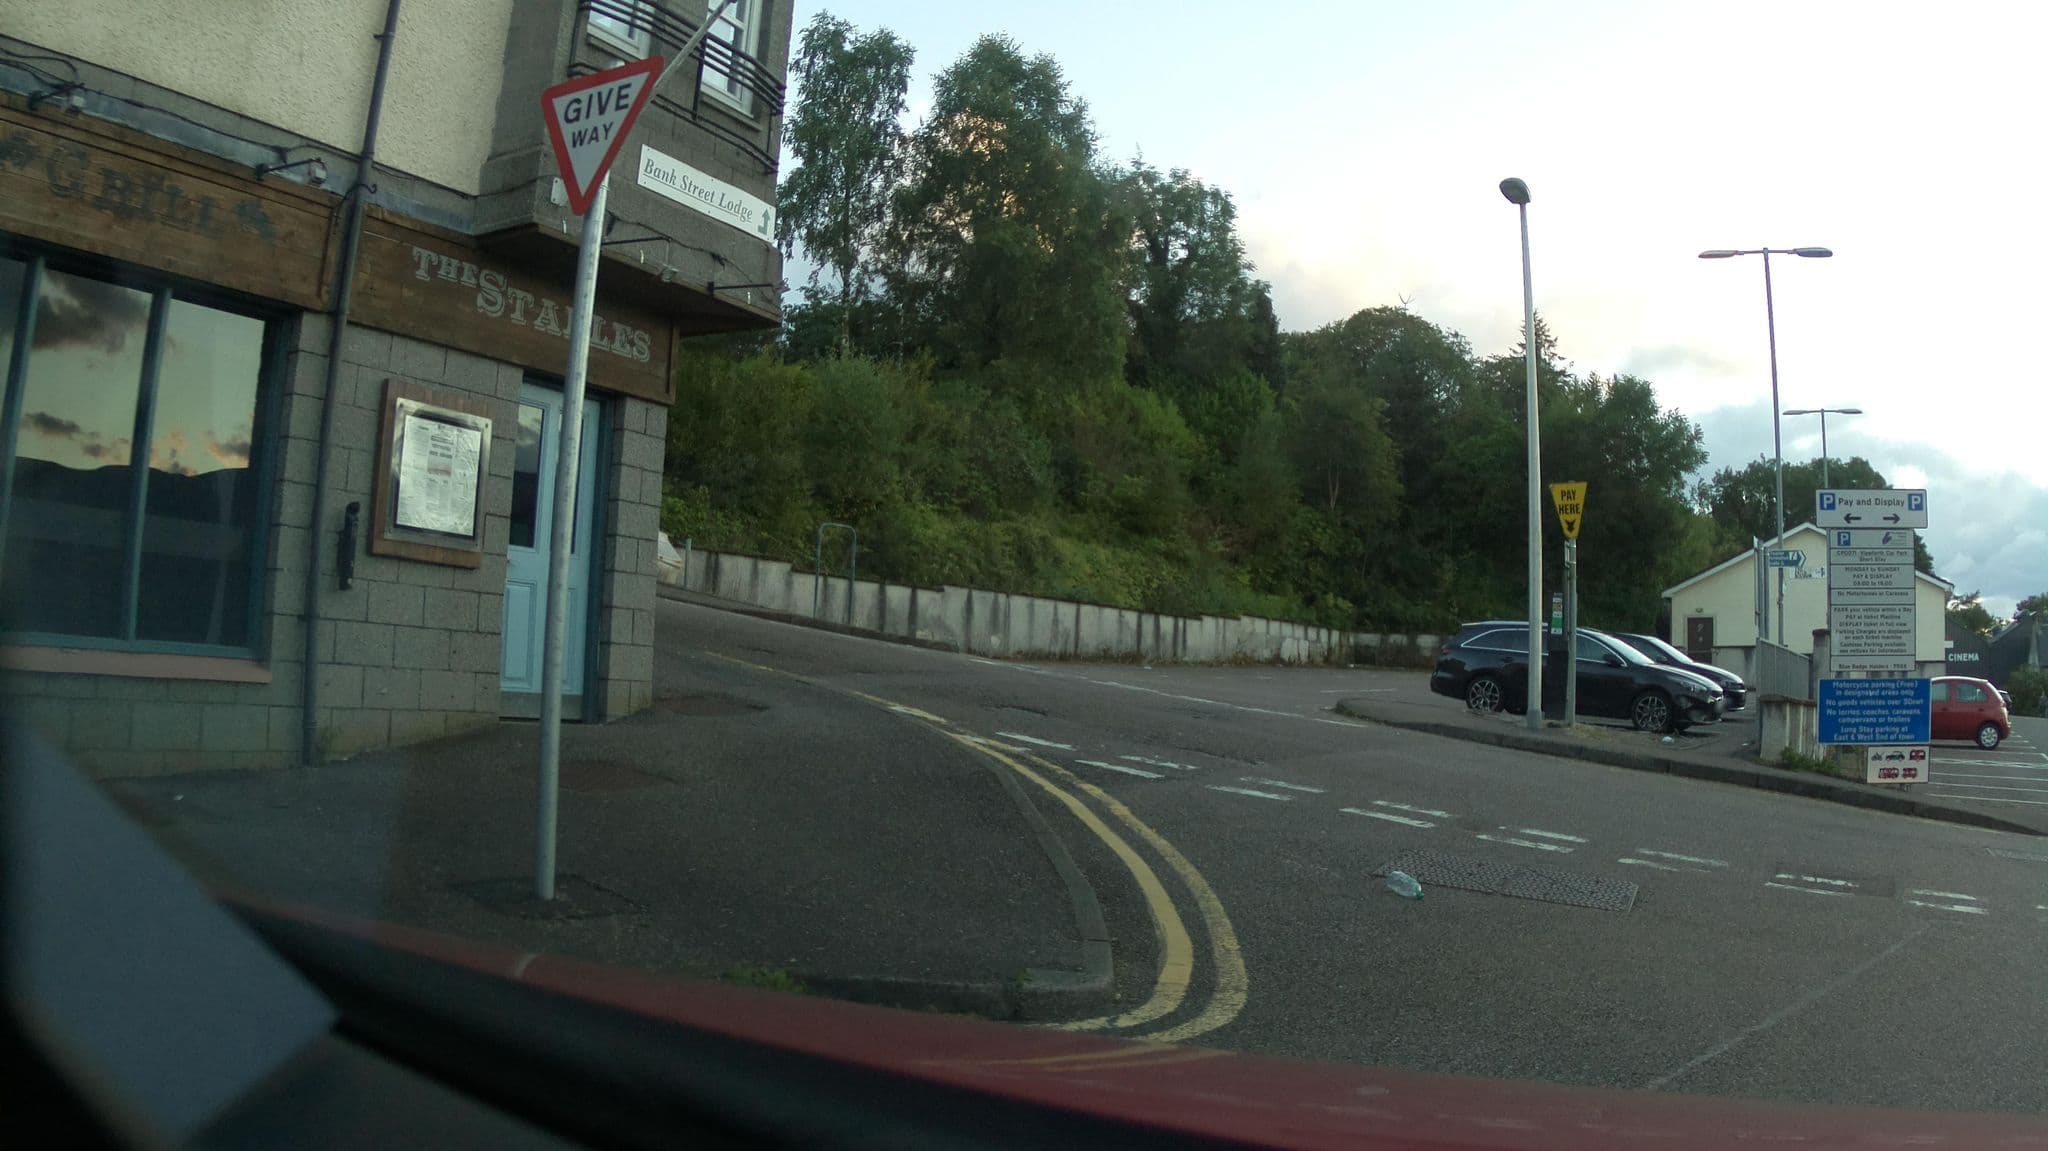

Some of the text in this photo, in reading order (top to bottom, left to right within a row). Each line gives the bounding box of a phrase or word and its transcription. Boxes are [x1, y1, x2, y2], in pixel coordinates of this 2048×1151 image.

[564, 83, 632, 124] GIVE
[571, 122, 614, 148] WAY
[643, 158, 753, 222] Bank Street Lodge
[413, 246, 479, 288] THE
[477, 270, 651, 362] STALES
[1560, 490, 1576, 501] PAY
[1838, 498, 1853, 507] Pay
[1856, 498, 1872, 506] and
[1875, 498, 1905, 507] Display
[1559, 503, 1580, 515] HERE
[1948, 653, 1979, 662] CINEMA
[1833, 681, 1869, 689] Motorcycle
[1871, 681, 1895, 689] parking
[1844, 689, 1880, 697] designated
[1875, 726, 1900, 734] parking
